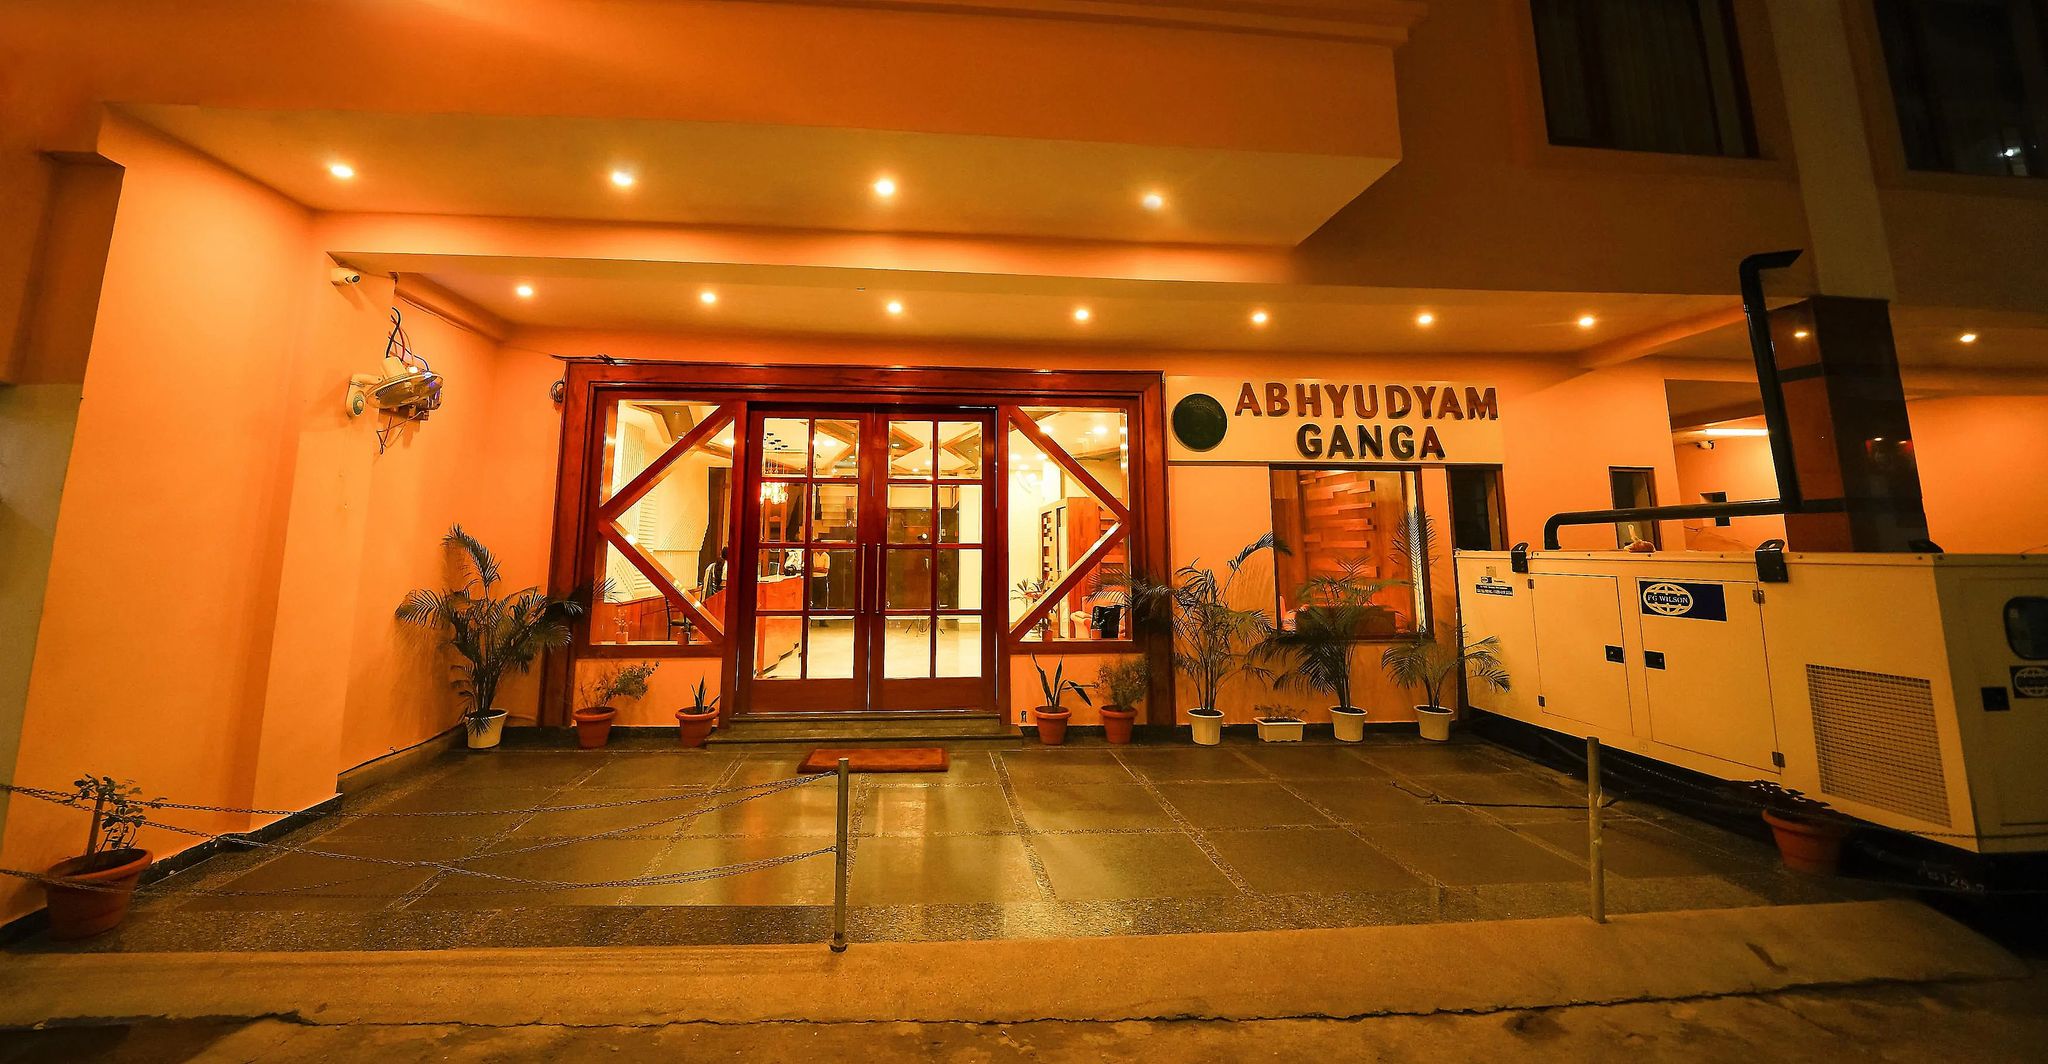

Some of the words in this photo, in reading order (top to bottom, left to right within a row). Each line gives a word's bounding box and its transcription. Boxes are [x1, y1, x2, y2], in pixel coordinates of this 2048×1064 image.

[1234, 382, 1498, 420] ABHYUDYAM
[1296, 424, 1446, 460] GANGA
[1659, 595, 1688, 603] WILSON
